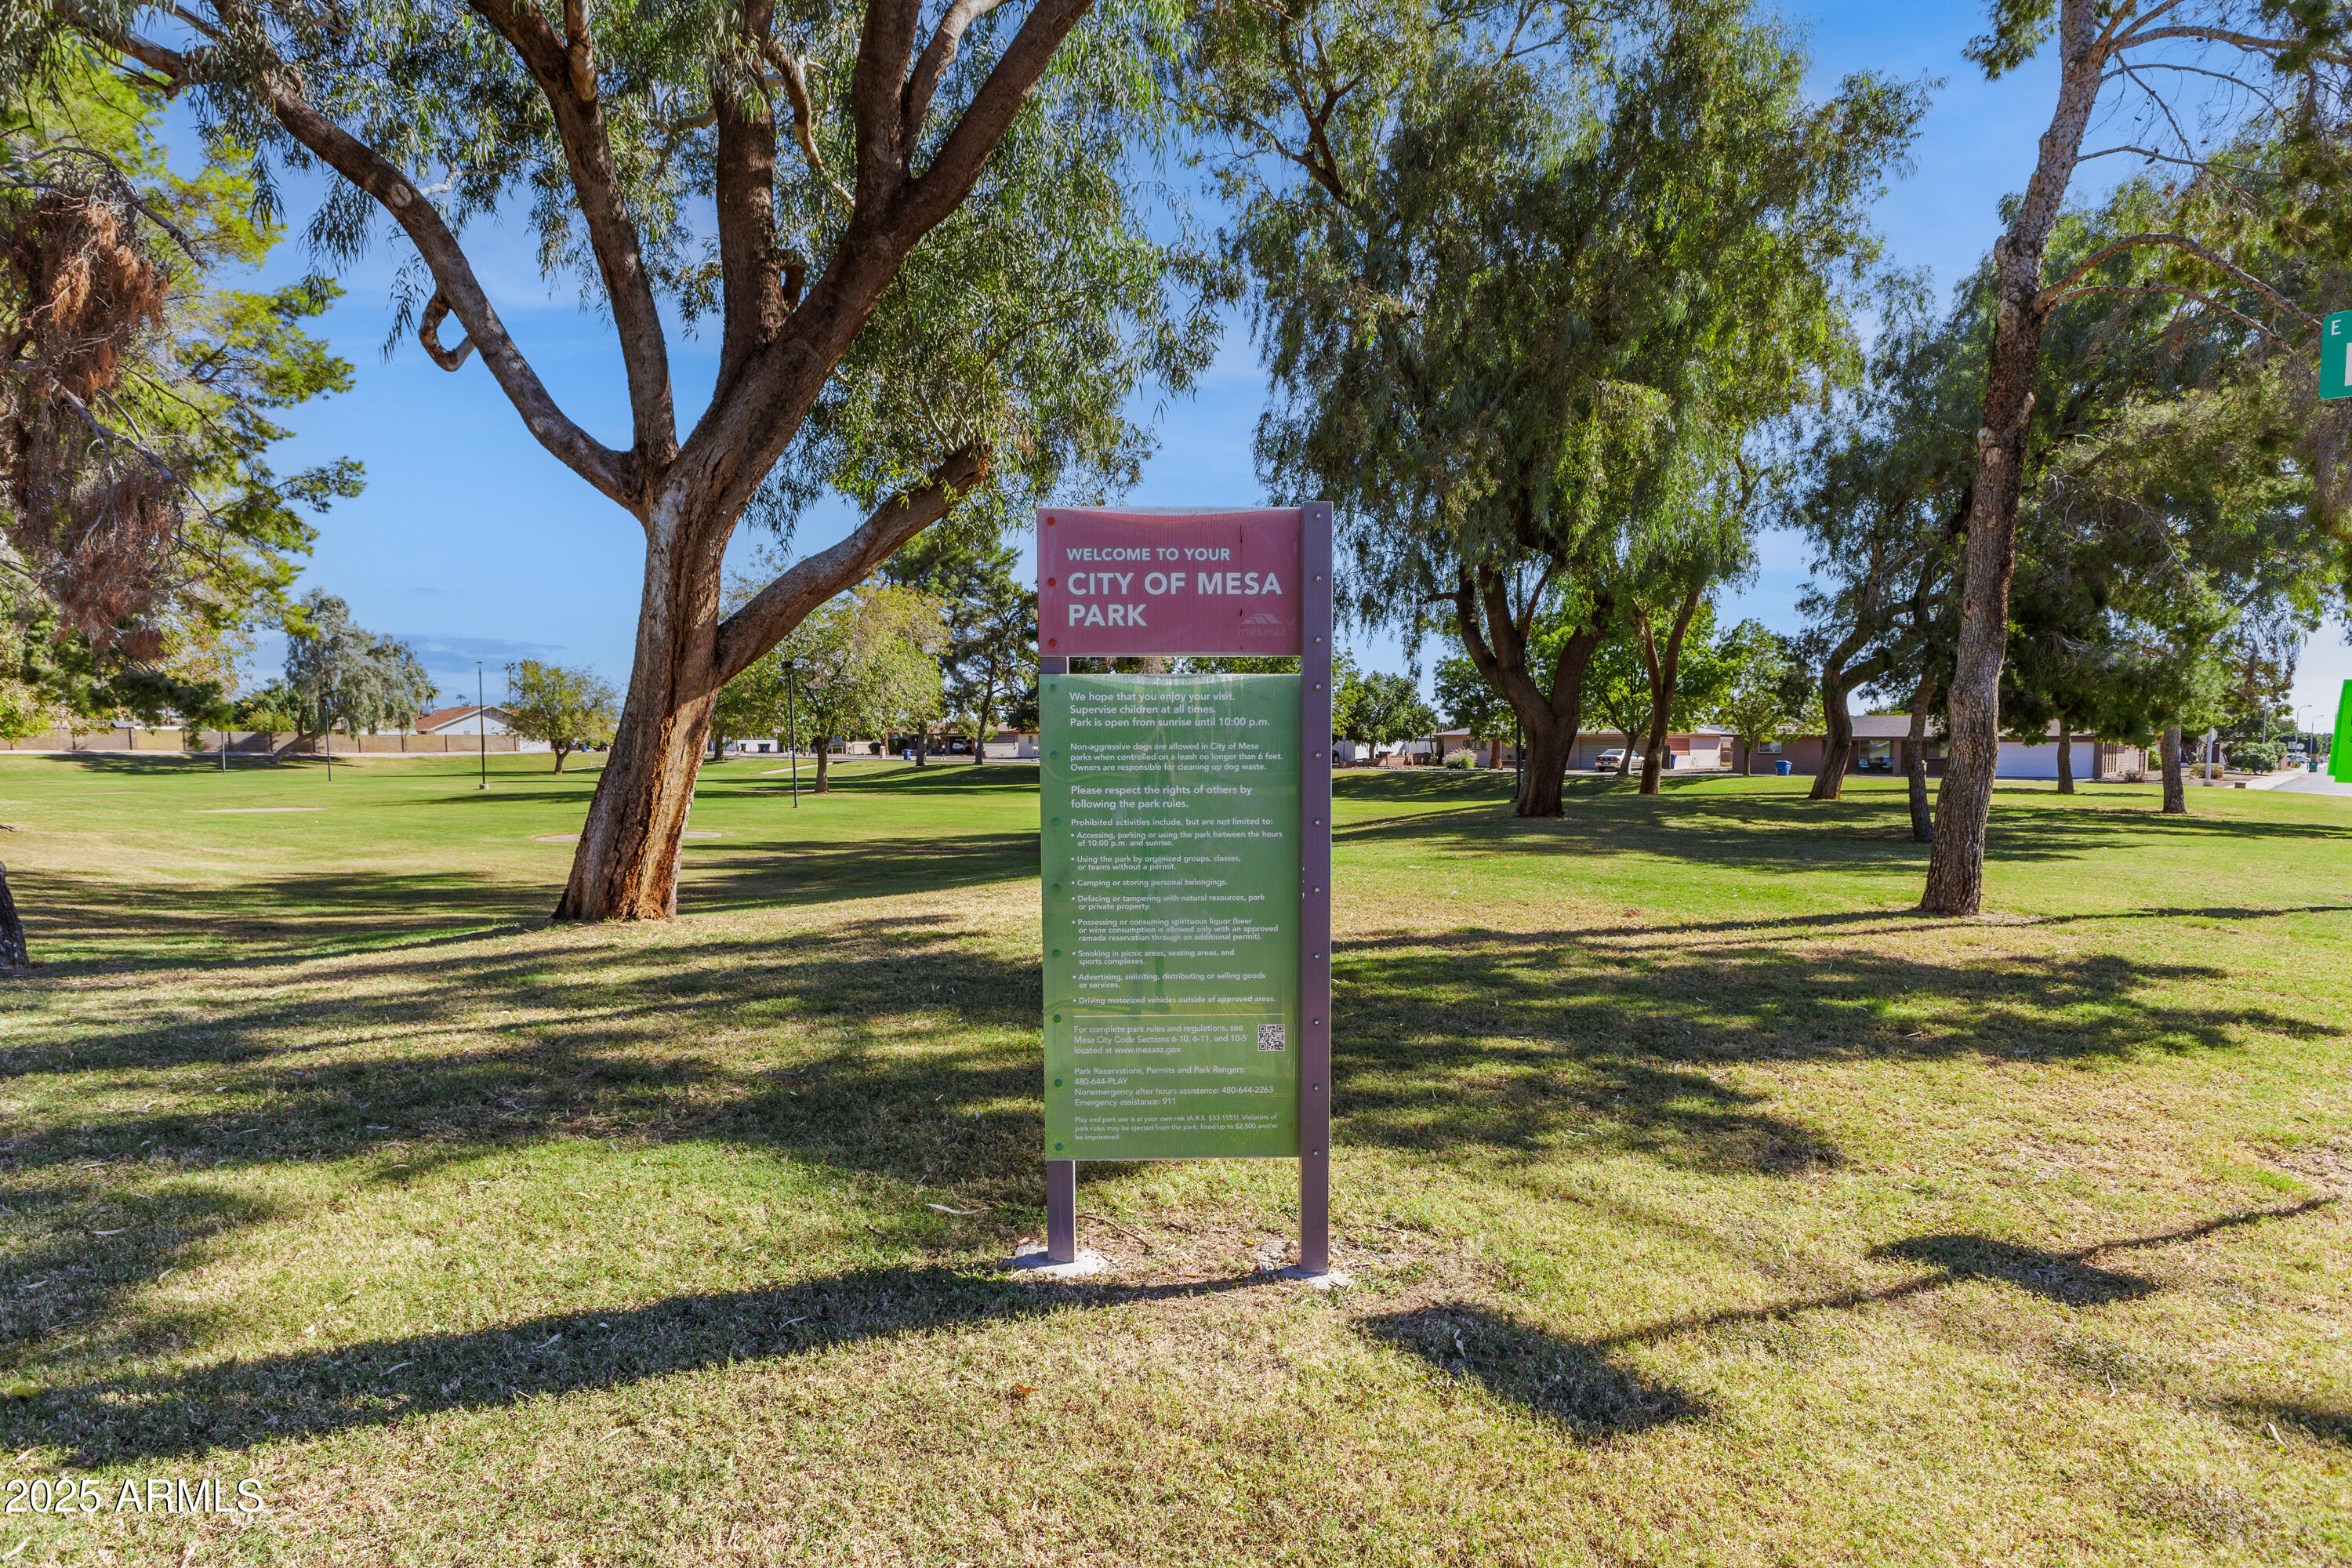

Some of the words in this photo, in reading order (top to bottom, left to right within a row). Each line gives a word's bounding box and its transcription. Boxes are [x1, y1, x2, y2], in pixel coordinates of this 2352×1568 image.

[2331, 319, 2342, 336] E
[1066, 547, 1151, 561] WELCOME
[1156, 547, 1179, 561] TO
[1184, 547, 1231, 561] YOUR
[1067, 572, 1134, 596] CITY
[1144, 572, 1186, 596] OF
[1197, 572, 1283, 596] MESA
[1068, 603, 1148, 627] PARK
[1069, 692, 1086, 701] We
[1088, 691, 1114, 703] hope
[1116, 691, 1136, 701] that
[1138, 694, 1156, 703] you
[1160, 691, 1185, 703] enjoy
[1189, 694, 1210, 702] your
[1213, 691, 1236, 700] visit.
[1069, 705, 1116, 716] Supervise
[1119, 704, 1158, 713] children
[1160, 705, 1171, 713] at
[1173, 704, 1184, 713] all
[1187, 704, 1217, 713] times.
[1070, 717, 1091, 727] Park
[1094, 717, 1102, 727] is
[1104, 720, 1129, 729] open
[1132, 717, 1155, 727] from
[1158, 717, 1191, 726] sunrise
[1194, 717, 1215, 726] until
[1218, 717, 1246, 726] 10:00
[1248, 720, 1271, 728] p.m.
[1070, 742, 1131, 753] Non-aggressive
[1132, 742, 1152, 752] dogs
[1210, 742, 1225, 752] City
[1070, 753, 1091, 763] parks
[1210, 752, 1236, 762] longer
[1117, 763, 1161, 773] responsible
[1177, 763, 1209, 772] cleaning
[1223, 763, 1239, 772] dog
[1071, 786, 1102, 794] Please
[1105, 786, 1141, 797] respect
[1143, 785, 1160, 794] the
[1163, 785, 1190, 797] rights
[1193, 785, 1203, 793] of
[1206, 785, 1237, 793] others
[1240, 785, 1252, 796] by
[1070, 799, 1116, 810] following
[1119, 799, 1135, 808] the
[1138, 798, 1160, 810] park
[1162, 798, 1189, 808] rules.
[1152, 818, 1183, 827] include,
[1076, 831, 1115, 840] Accessing,
[1117, 831, 1145, 840] parking
[1158, 830, 1178, 840] using
[1194, 830, 1210, 840] park
[1077, 878, 1110, 888] Camping
[1122, 878, 1149, 887] storing
[1150, 878, 1182, 887] personal
[1184, 877, 1228, 887] belongings.
[1077, 894, 1110, 904] Defacing
[1122, 894, 1161, 903] tampering
[1247, 893, 1265, 902] park
[1078, 972, 1123, 982] Advertising,
[1124, 972, 1160, 982] soliciting,
[1161, 972, 1204, 982] distributing
[1216, 971, 1240, 982] selling
[1242, 971, 1265, 981] goods
[1078, 996, 1105, 1006] Driving
[1217, 995, 1253, 1004] approved
[1088, 1024, 1125, 1035] complete
[1127, 1024, 1144, 1034] park
[1183, 1023, 1227, 1034] regulations,
[1096, 1035, 1112, 1046] City
[1114, 1035, 1134, 1044] Code
[1230, 1033, 1247, 1042] 10-5
[1074, 1066, 1091, 1075] Park
[1093, 1066, 1144, 1076] Reservations,
[1145, 1065, 1175, 1074] Permits
[1177, 1065, 1192, 1074] and
[1212, 1065, 1246, 1076] Rangers:
[1074, 1087, 1133, 1098] Nonemergency
[1178, 1086, 1219, 1094] assistance:
[1075, 1098, 1117, 1108] Emergency
[1120, 1097, 1160, 1105] assistance:
